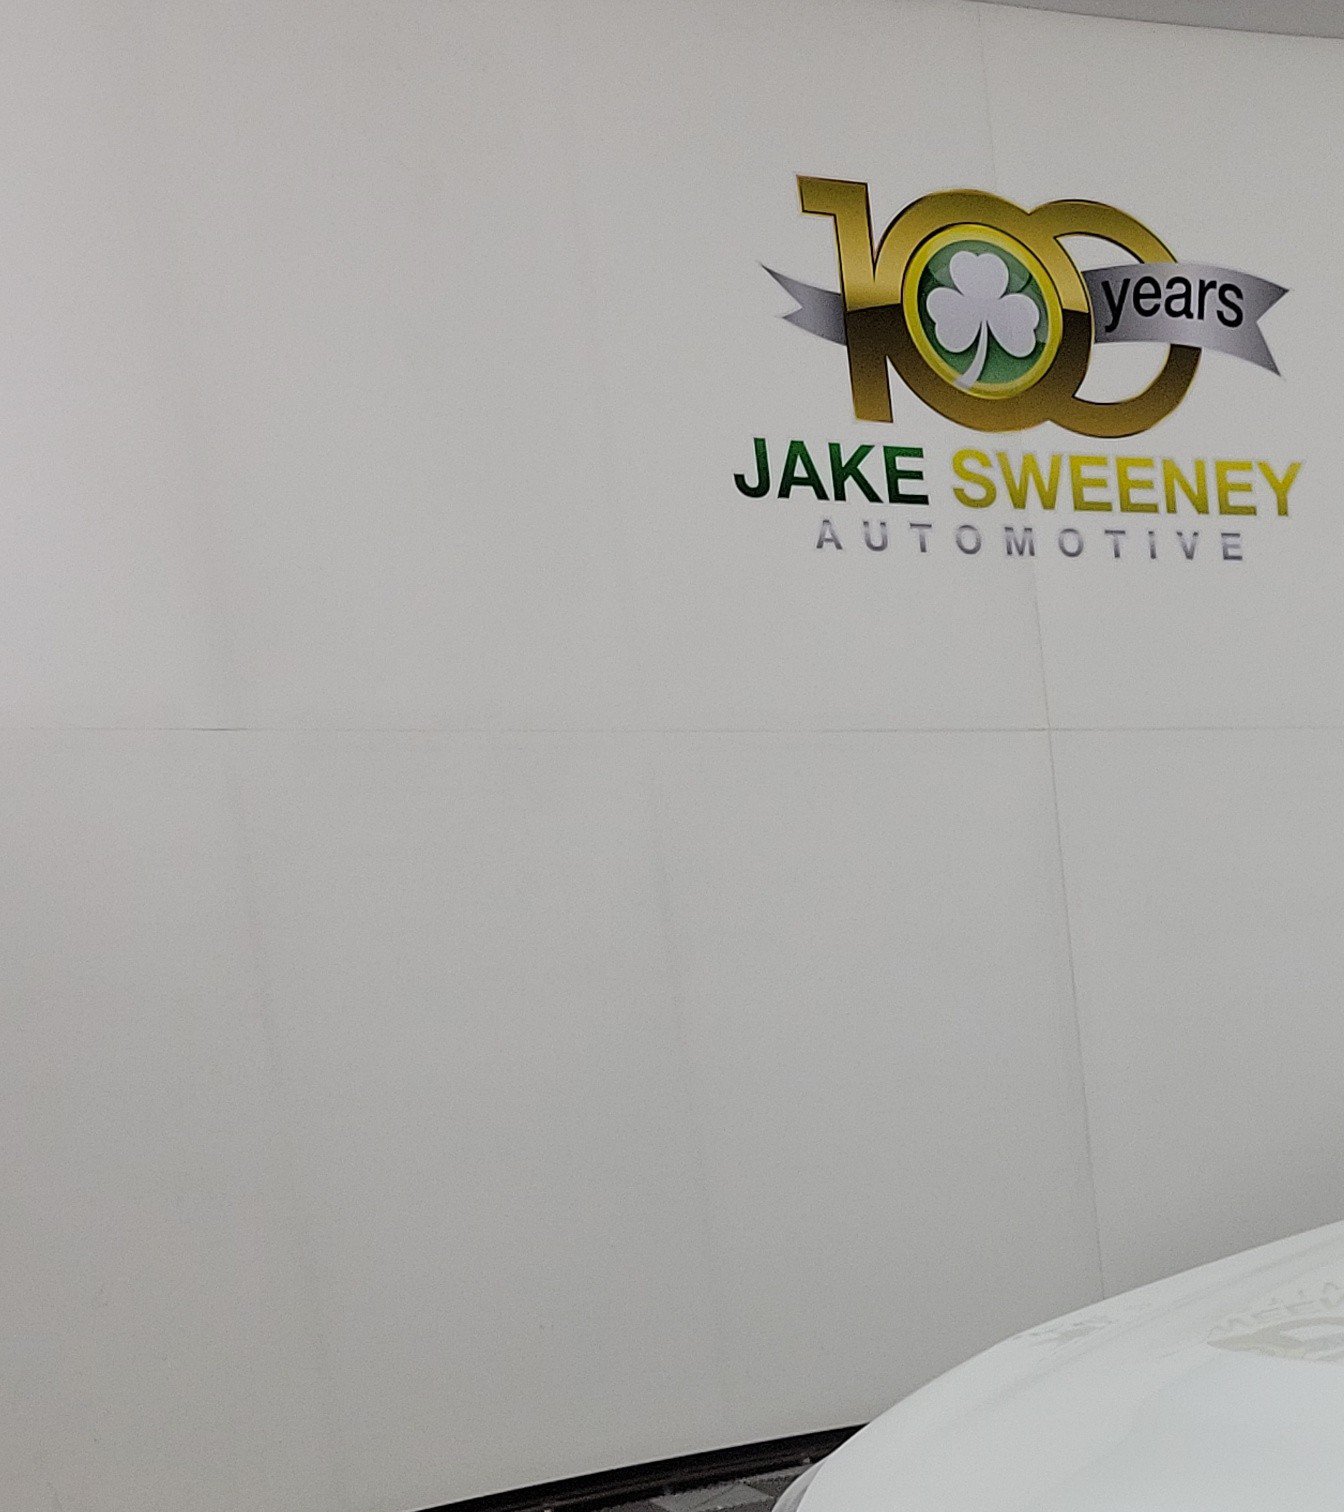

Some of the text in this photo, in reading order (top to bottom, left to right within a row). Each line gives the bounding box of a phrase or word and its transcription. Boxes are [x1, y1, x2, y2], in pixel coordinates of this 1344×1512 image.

[796, 174, 1245, 439] 100 years
[733, 436, 1303, 517] JAKE SWEENEY
[815, 519, 1244, 562] AUTOMOTIVE
